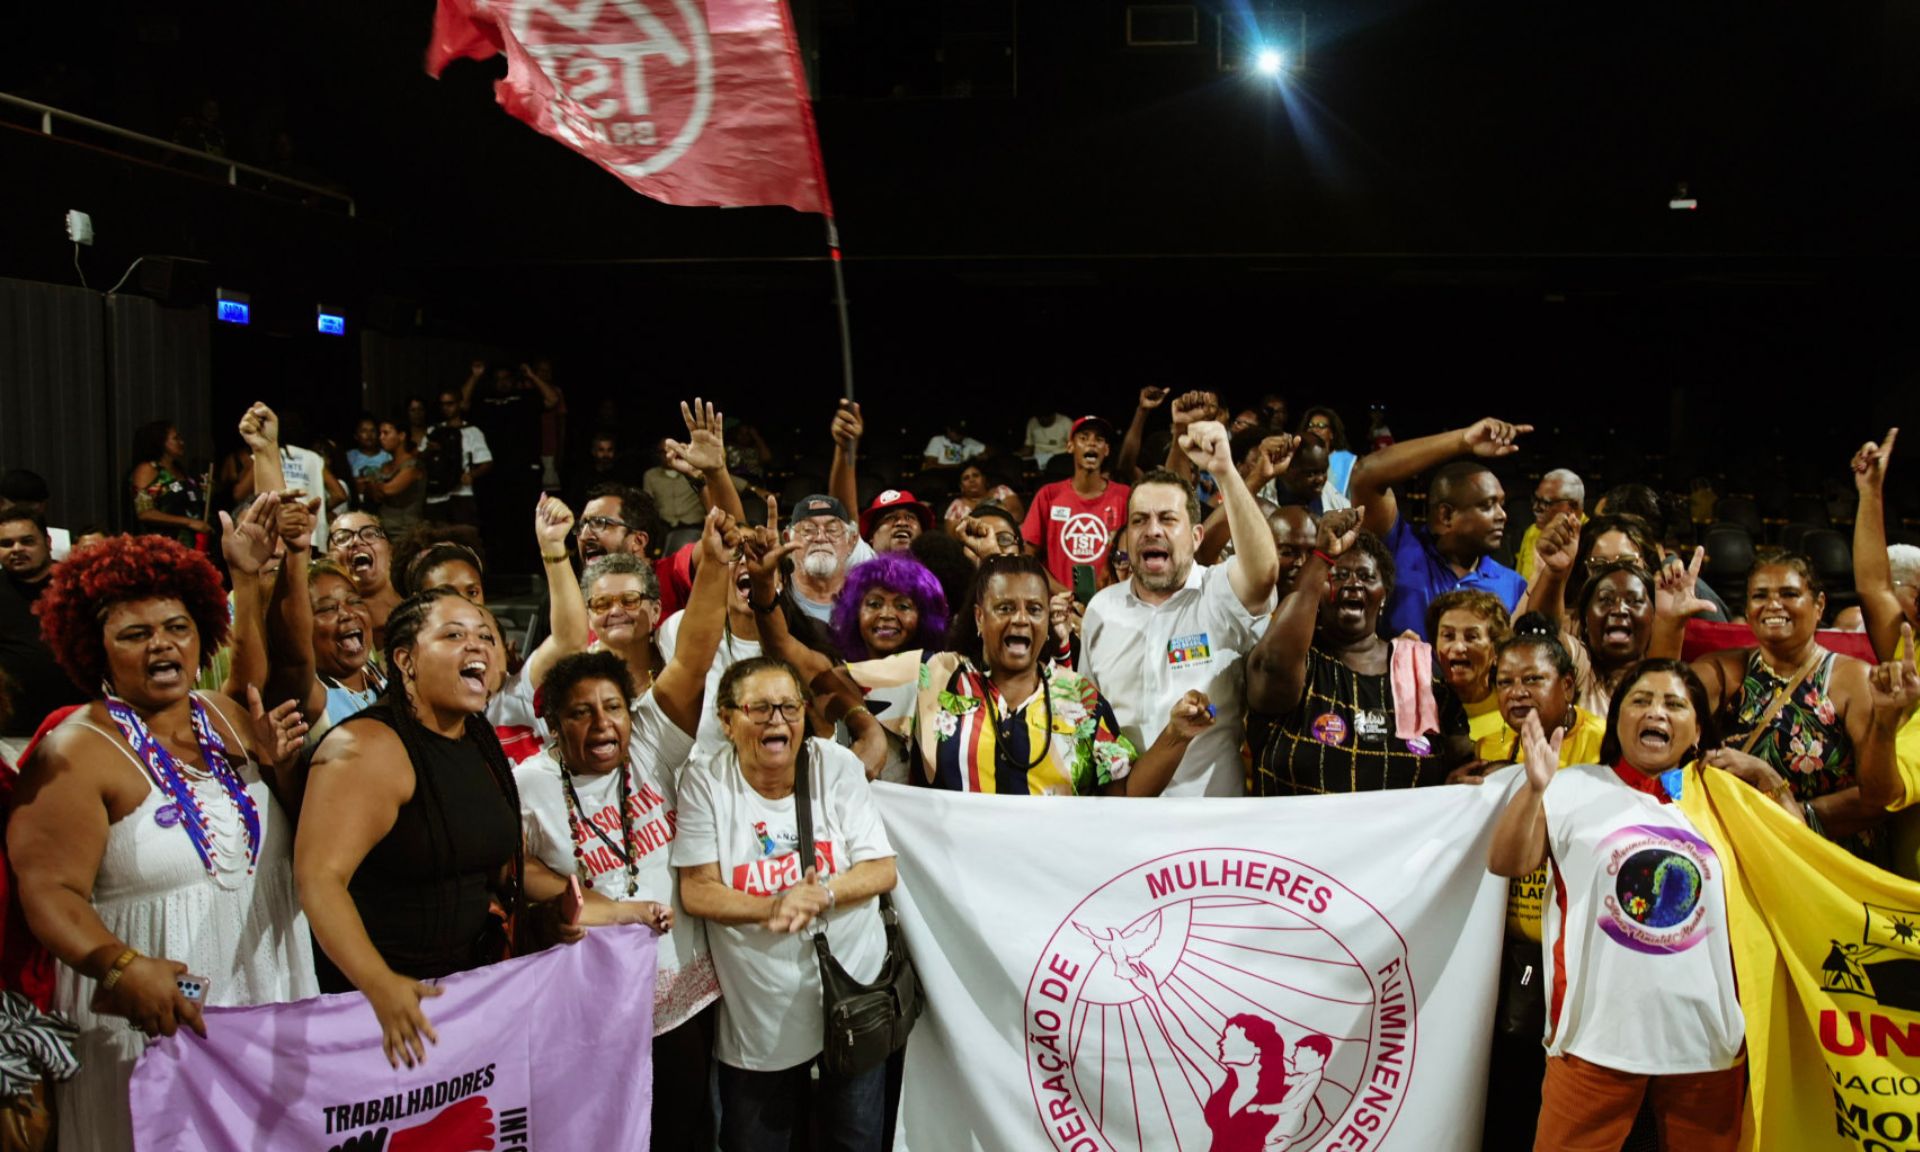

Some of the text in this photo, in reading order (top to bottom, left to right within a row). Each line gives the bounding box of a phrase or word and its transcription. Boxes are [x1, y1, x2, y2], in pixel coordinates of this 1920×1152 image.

[1039, 953, 1080, 1003] DE
[1145, 859, 1333, 914] MULHERES
[323, 1063, 496, 1135] TRABALHADORES
[1832, 1086, 1920, 1143] MO
